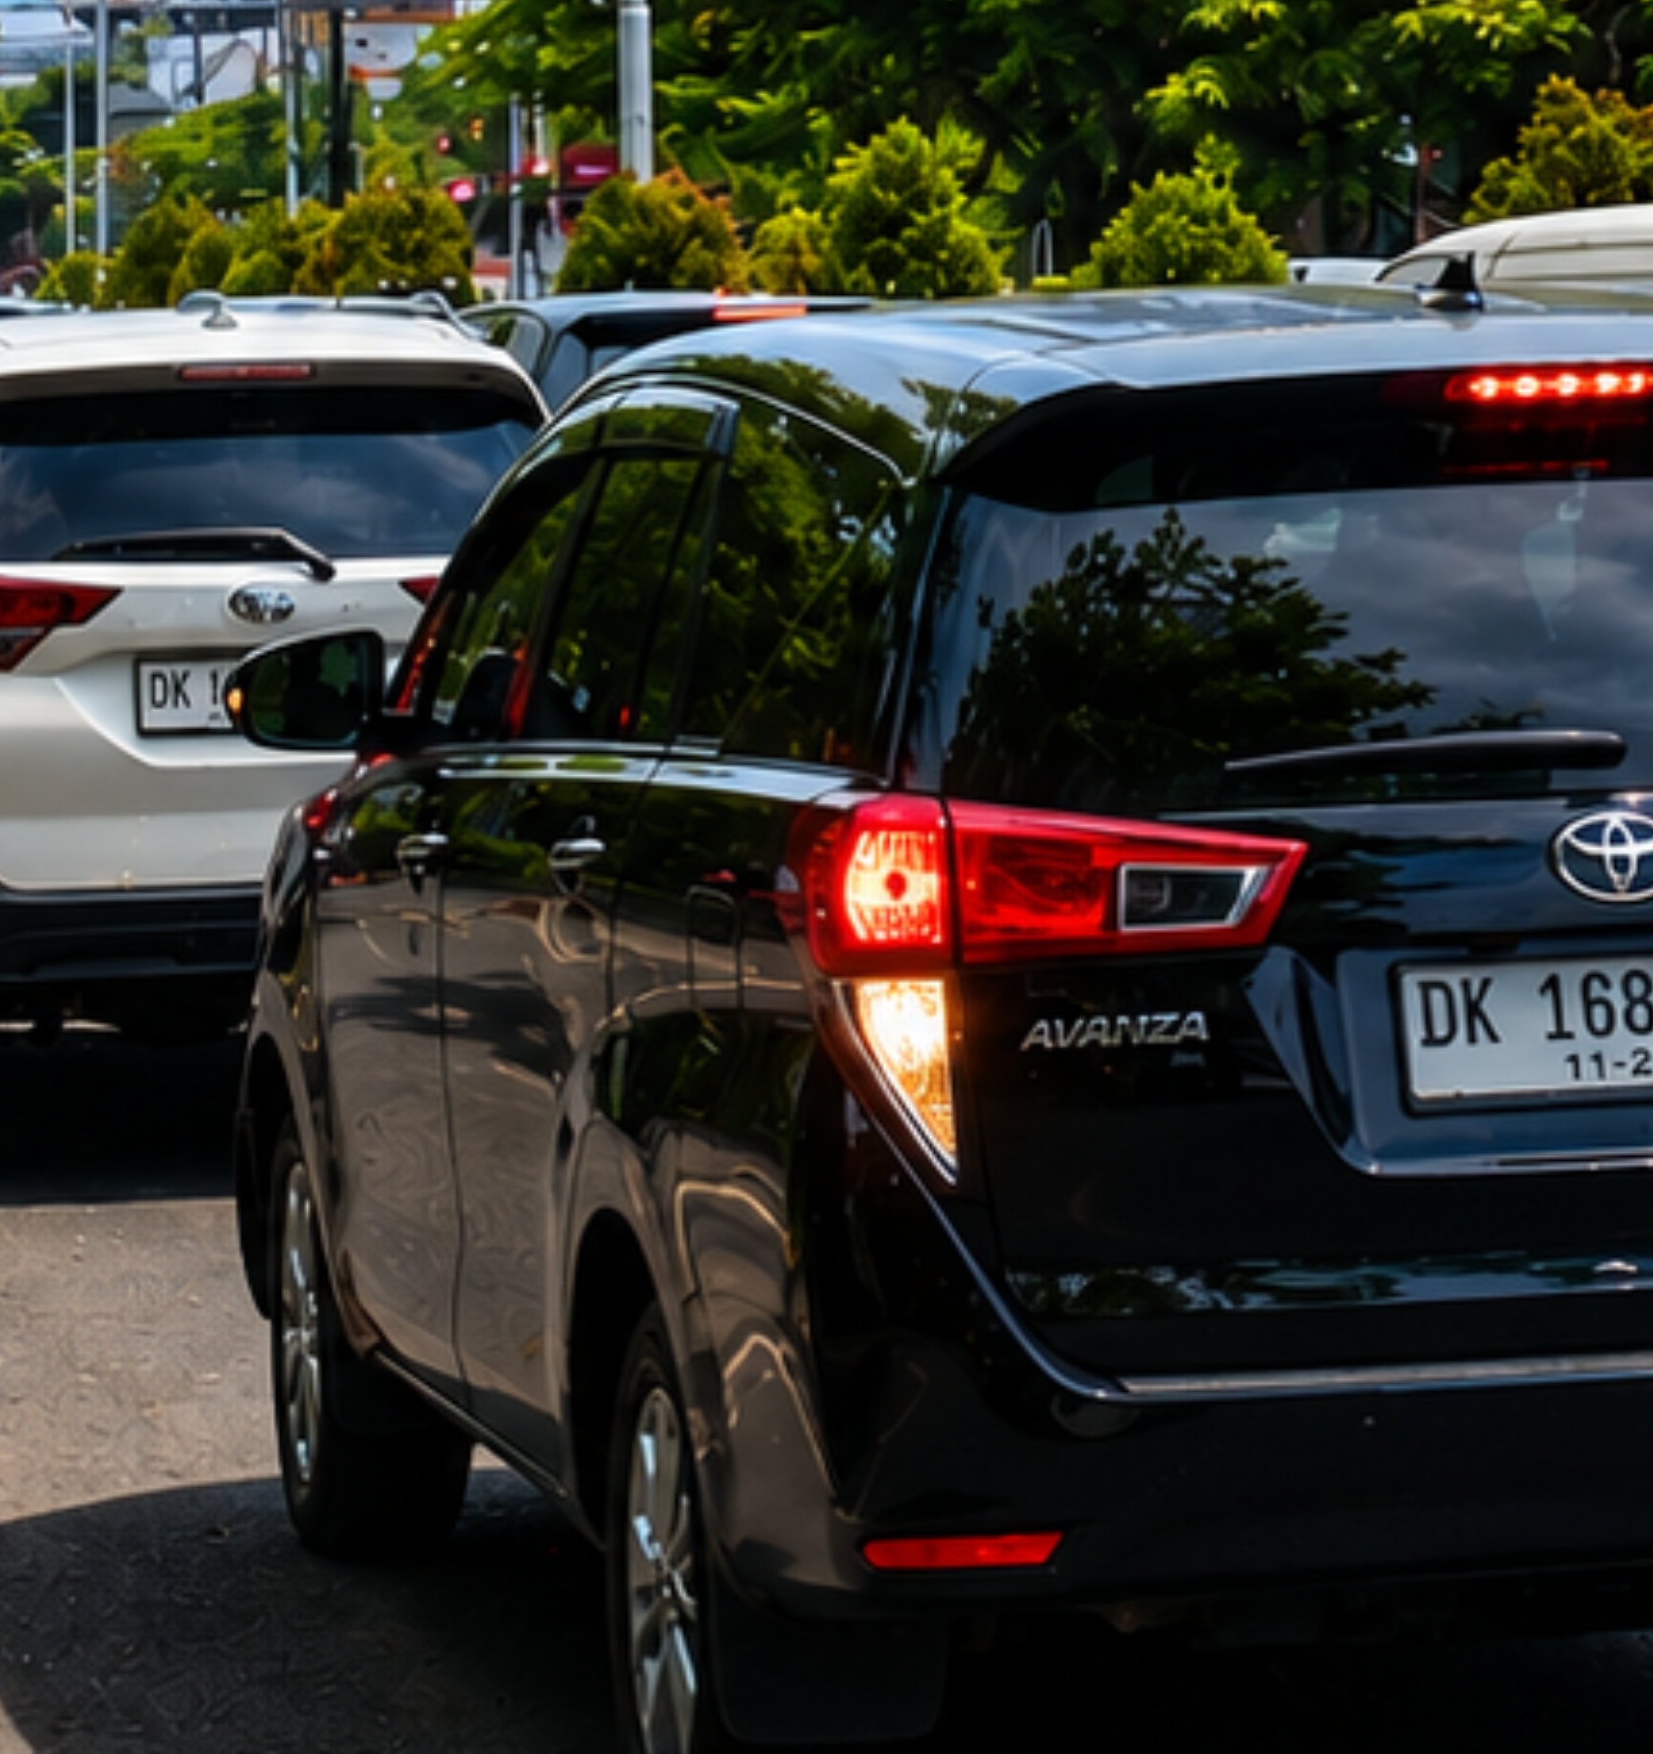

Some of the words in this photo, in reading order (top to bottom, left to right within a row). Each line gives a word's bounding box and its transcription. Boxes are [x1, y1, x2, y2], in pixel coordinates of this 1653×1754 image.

[151, 670, 191, 708] DK
[1020, 1010, 1209, 1051] AVANZA
[1417, 976, 1501, 1047] DK
